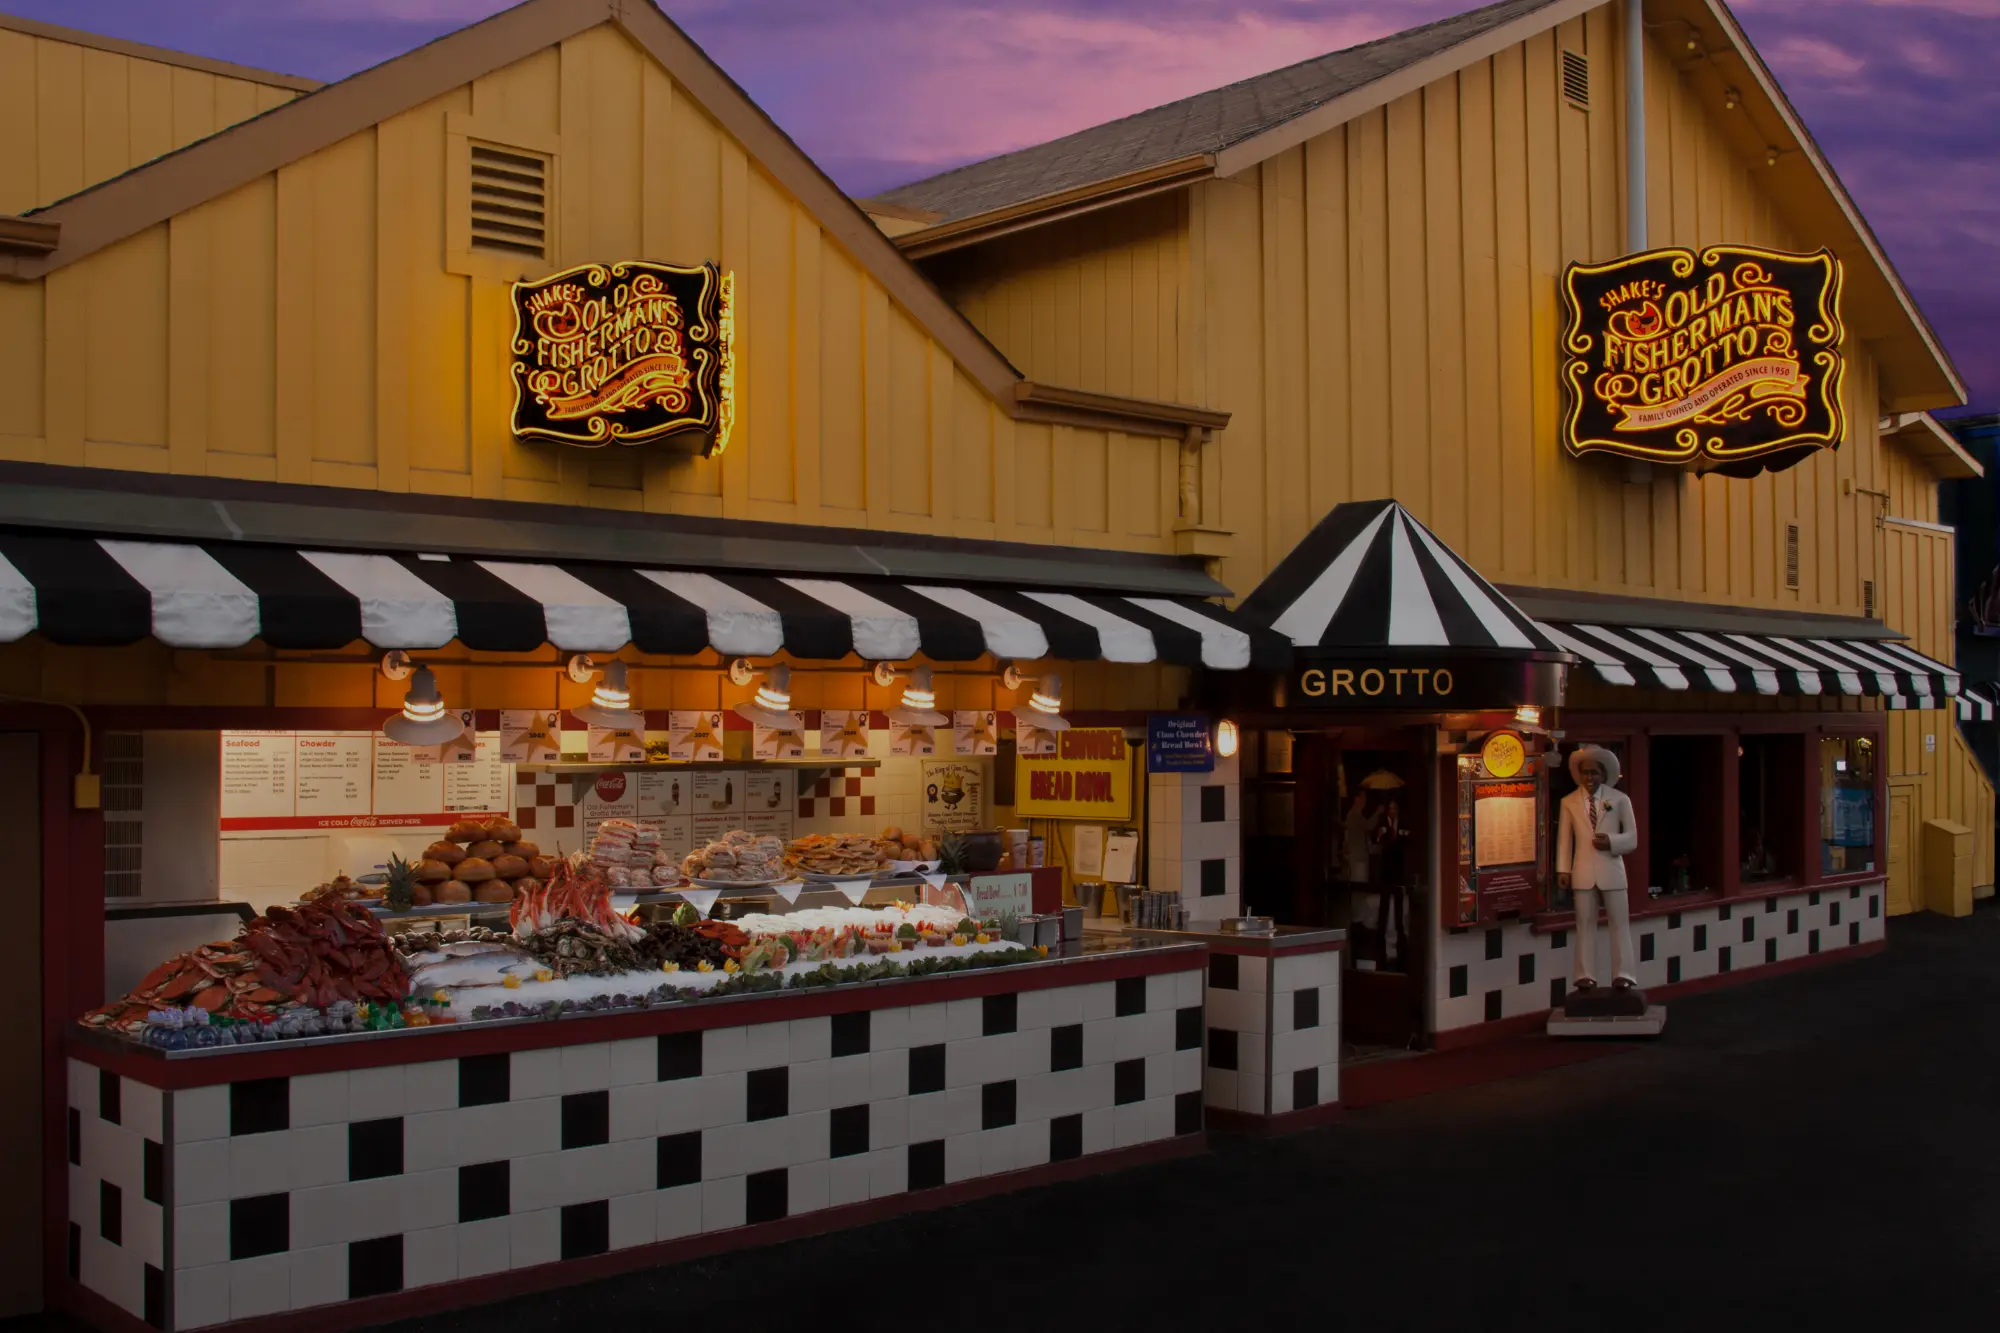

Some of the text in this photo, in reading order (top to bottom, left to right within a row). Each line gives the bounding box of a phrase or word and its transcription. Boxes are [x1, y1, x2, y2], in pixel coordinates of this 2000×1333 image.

[525, 283, 585, 315] SHAKE'S
[583, 283, 629, 332] OLD
[1599, 279, 1666, 312] SHAKE'S
[1665, 272, 1726, 329] OLD
[537, 299, 680, 367] FISHERMAN'S
[1602, 292, 1795, 374] FISHERMAN'S
[563, 327, 650, 395] GROTTO
[643, 364, 661, 373] SINCE
[1639, 325, 1758, 406] GROTTO
[1638, 366, 1790, 423] FAMILY OWNED AND OPERATED SINCE 1950
[1301, 668, 1453, 696] GROTTO
[300, 740, 336, 748] Chowder
[1031, 770, 1115, 802] BREAD BOWL
